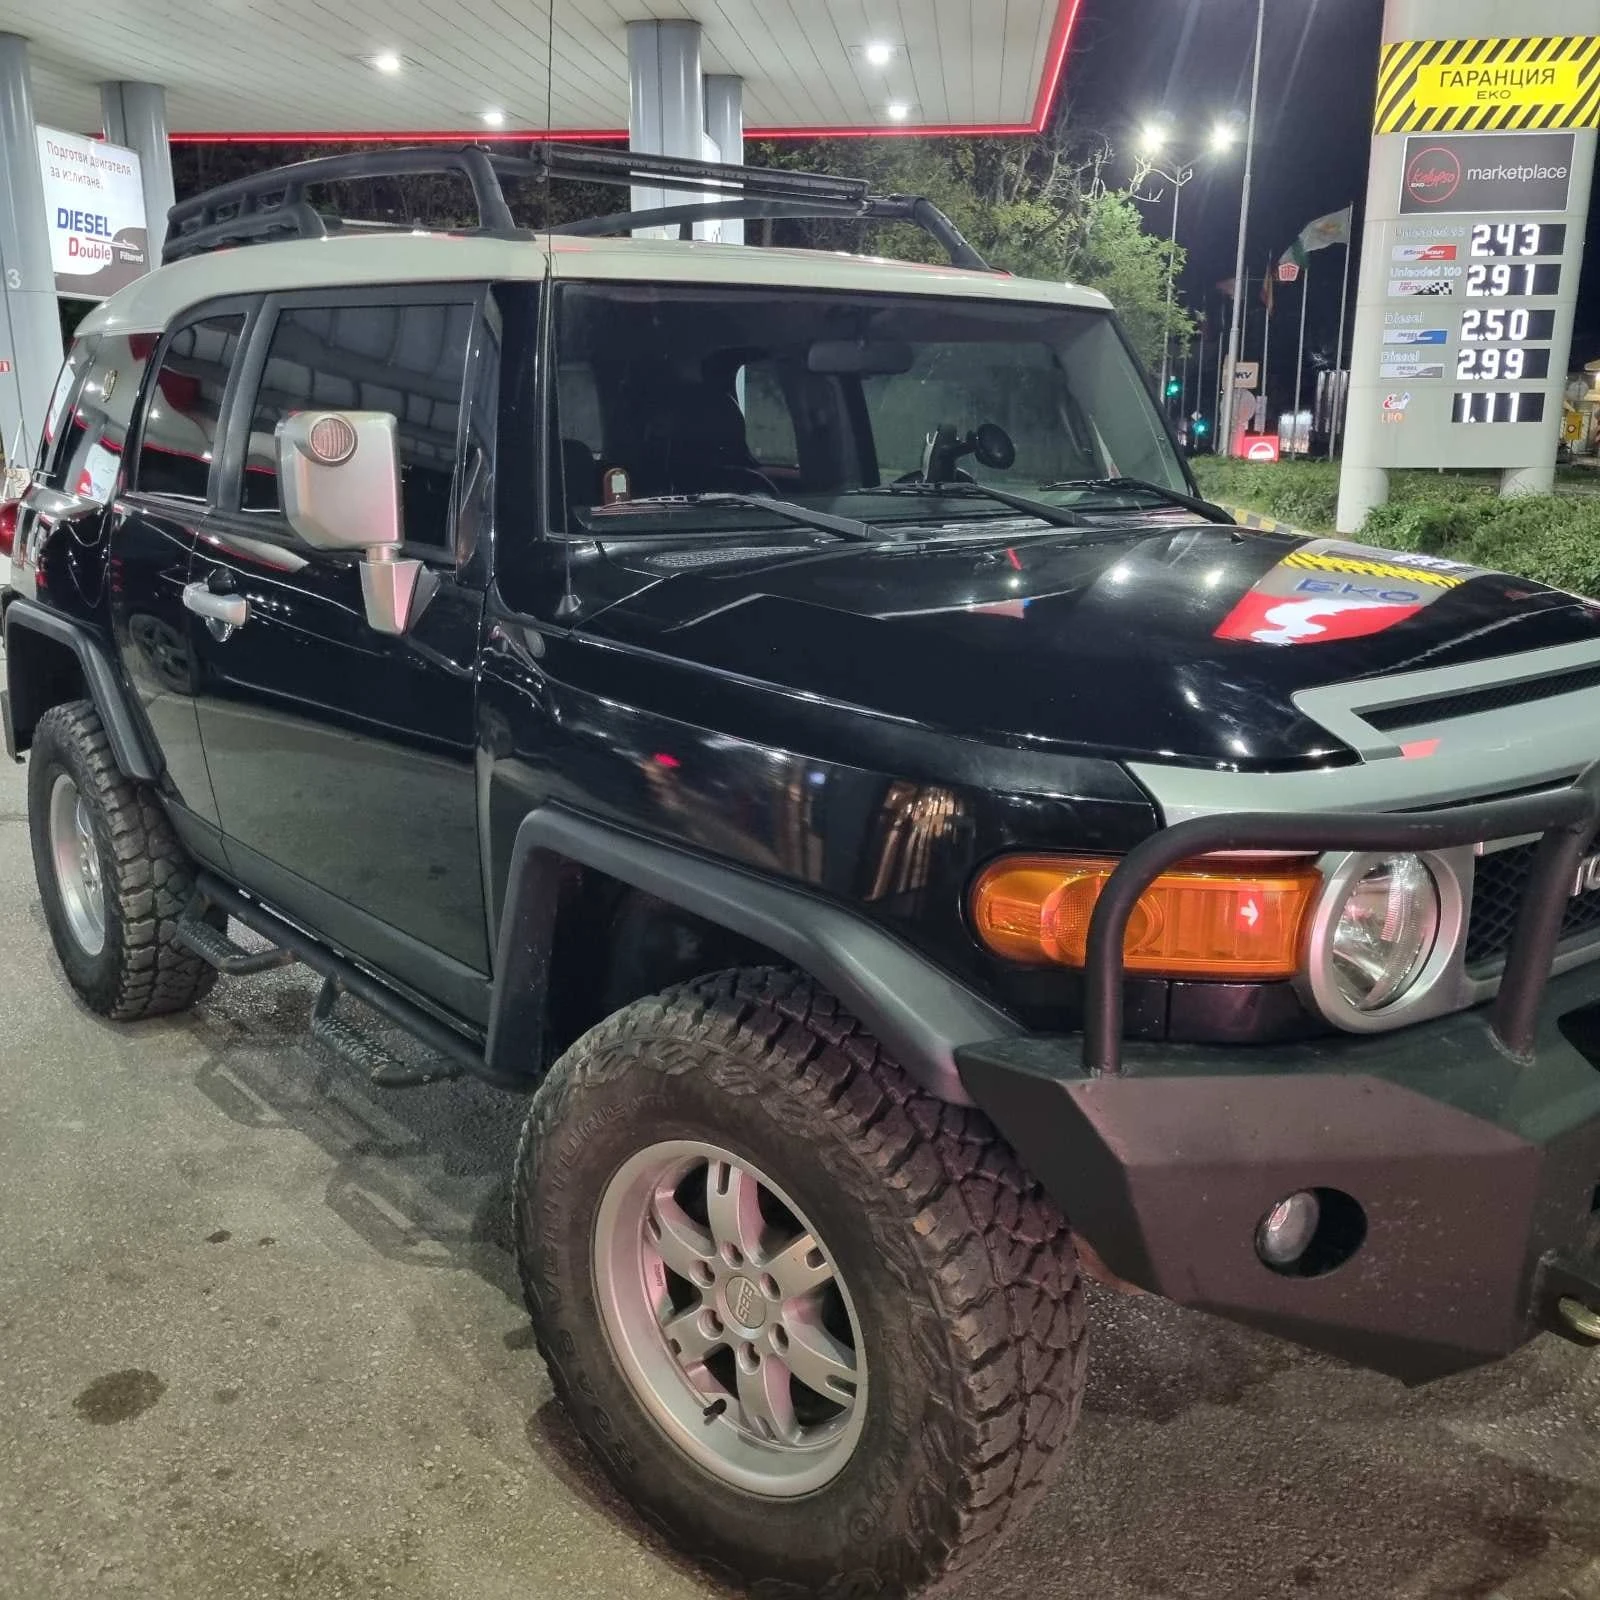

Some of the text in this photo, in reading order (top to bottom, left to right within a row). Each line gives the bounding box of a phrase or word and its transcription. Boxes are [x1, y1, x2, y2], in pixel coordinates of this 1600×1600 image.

[1440, 68, 1555, 88] ГАРАНЦИЯ
[1476, 90, 1511, 100] EKO
[47, 140, 131, 176] Подготви двигателя
[50, 166, 60, 178] за
[1467, 164, 1567, 182] marketplace
[57, 207, 112, 237] DIESEL
[69, 236, 111, 260] Double
[1471, 224, 1540, 256] 2.43
[8, 268, 21, 289] 3
[1466, 264, 1536, 296] 2.91
[1461, 309, 1529, 341] 2.50
[1456, 349, 1525, 380] 2.99
[1461, 392, 1520, 423] 1.11
